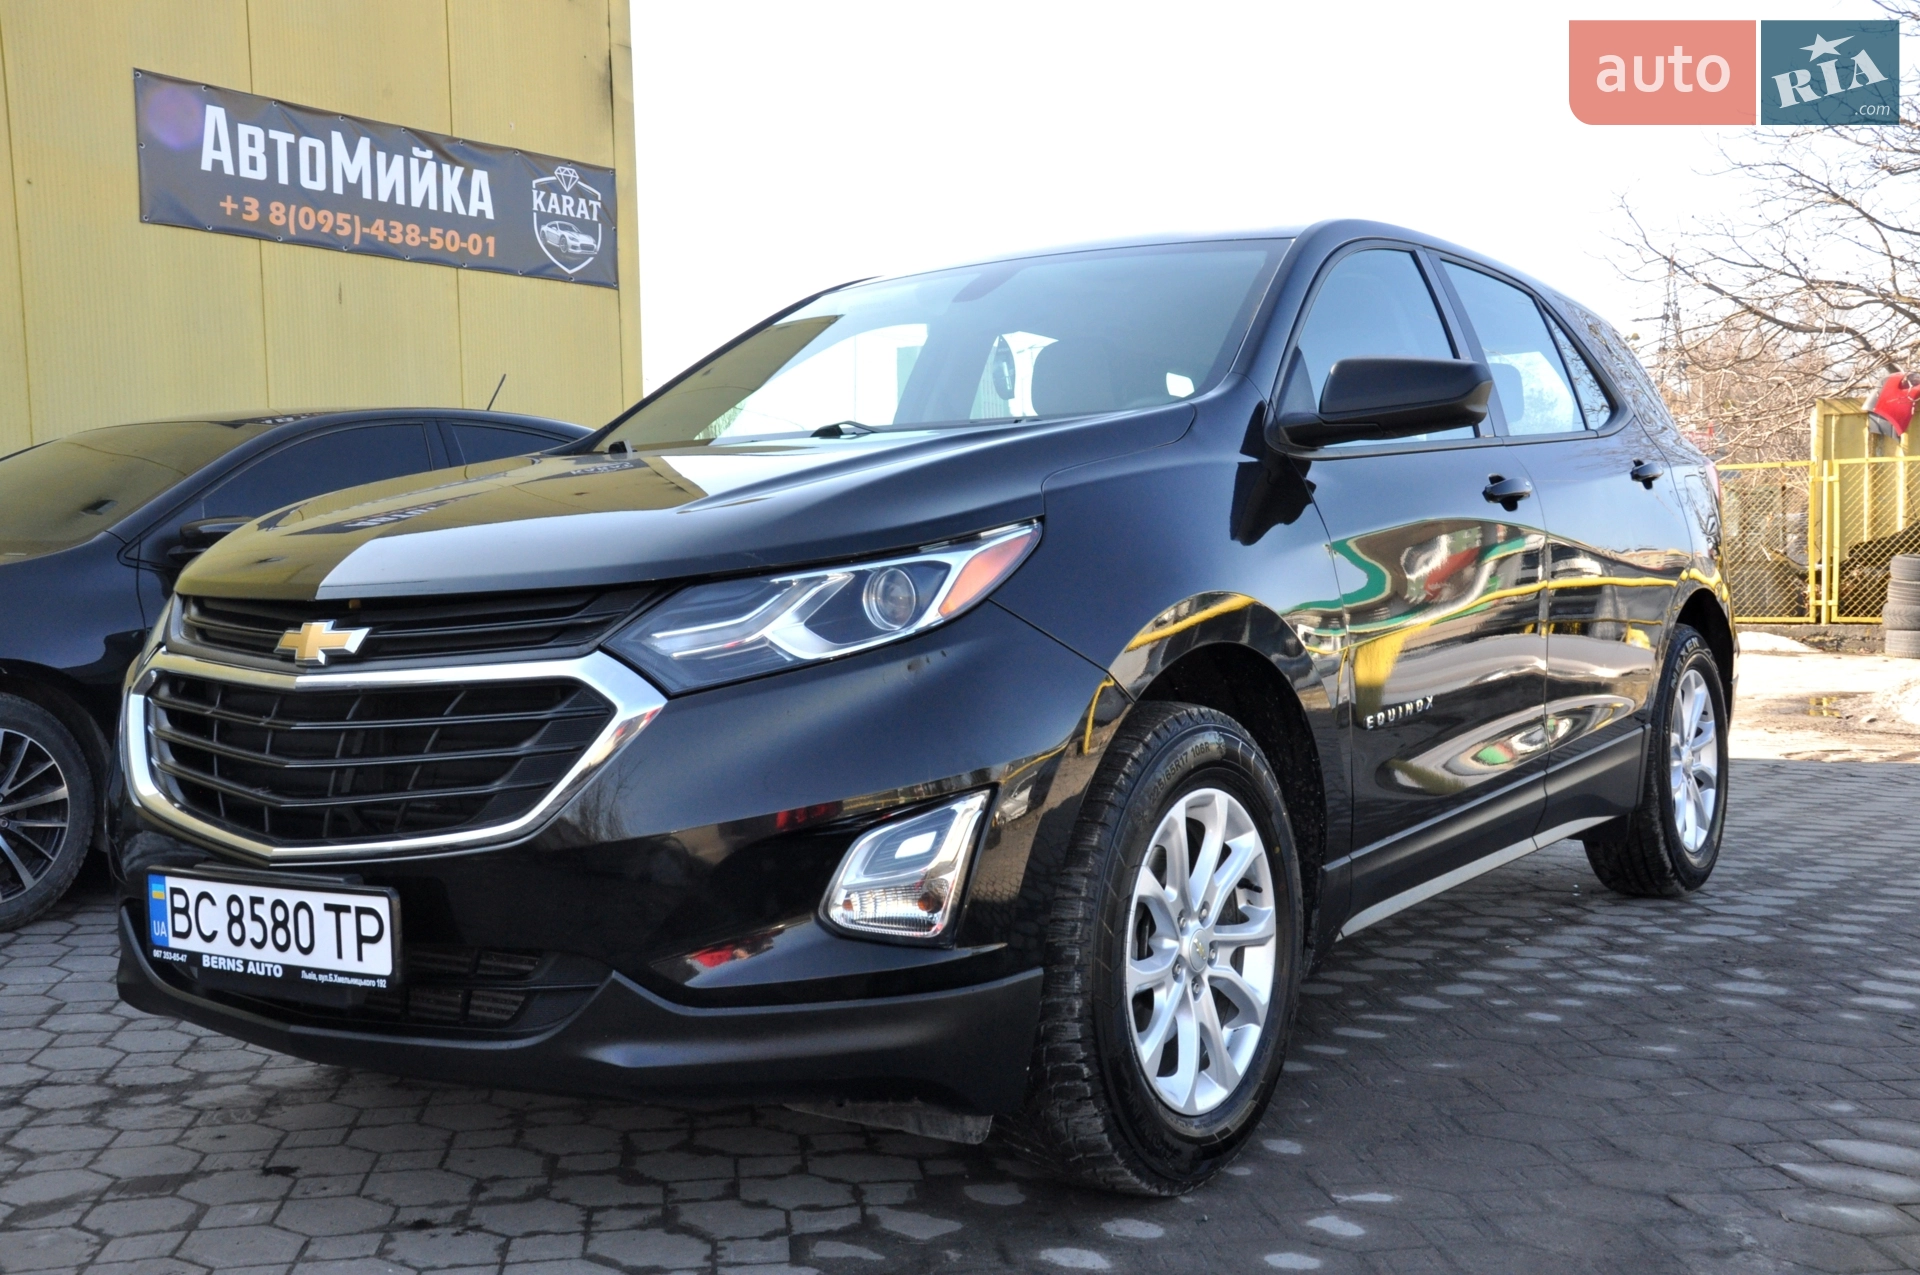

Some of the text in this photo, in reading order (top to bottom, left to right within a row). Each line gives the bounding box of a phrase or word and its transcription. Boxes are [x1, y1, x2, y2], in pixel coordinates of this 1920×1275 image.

[532, 189, 602, 222] KARAT
[268, 201, 495, 258] 8(095)-438-50-01
[1366, 695, 1434, 730] EQUINOX
[153, 920, 167, 938] UA
[169, 886, 385, 963] BC 8580 TP
[202, 954, 283, 978] BERNS AUTO
